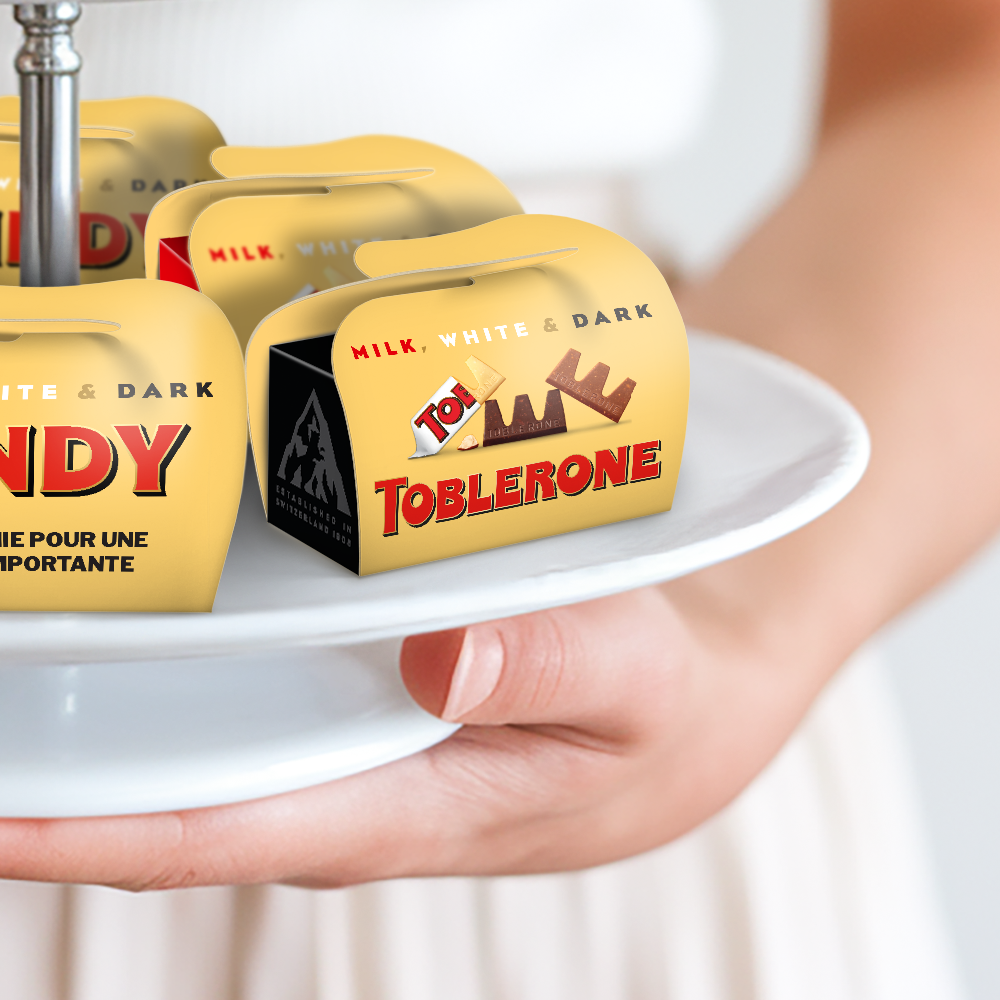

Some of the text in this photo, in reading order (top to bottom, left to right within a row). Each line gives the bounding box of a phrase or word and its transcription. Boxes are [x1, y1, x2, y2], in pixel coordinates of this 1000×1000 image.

[131, 179, 207, 193] DAR
[350, 304, 653, 360] MILK, WHITE & DARK
[77, 383, 96, 400] &
[118, 381, 214, 399] DARK
[374, 439, 662, 537] TOBLERONE
[276, 485, 352, 534] ESTABLISHED IN
[30, 531, 97, 548] POUR
[101, 531, 149, 548] UNE
